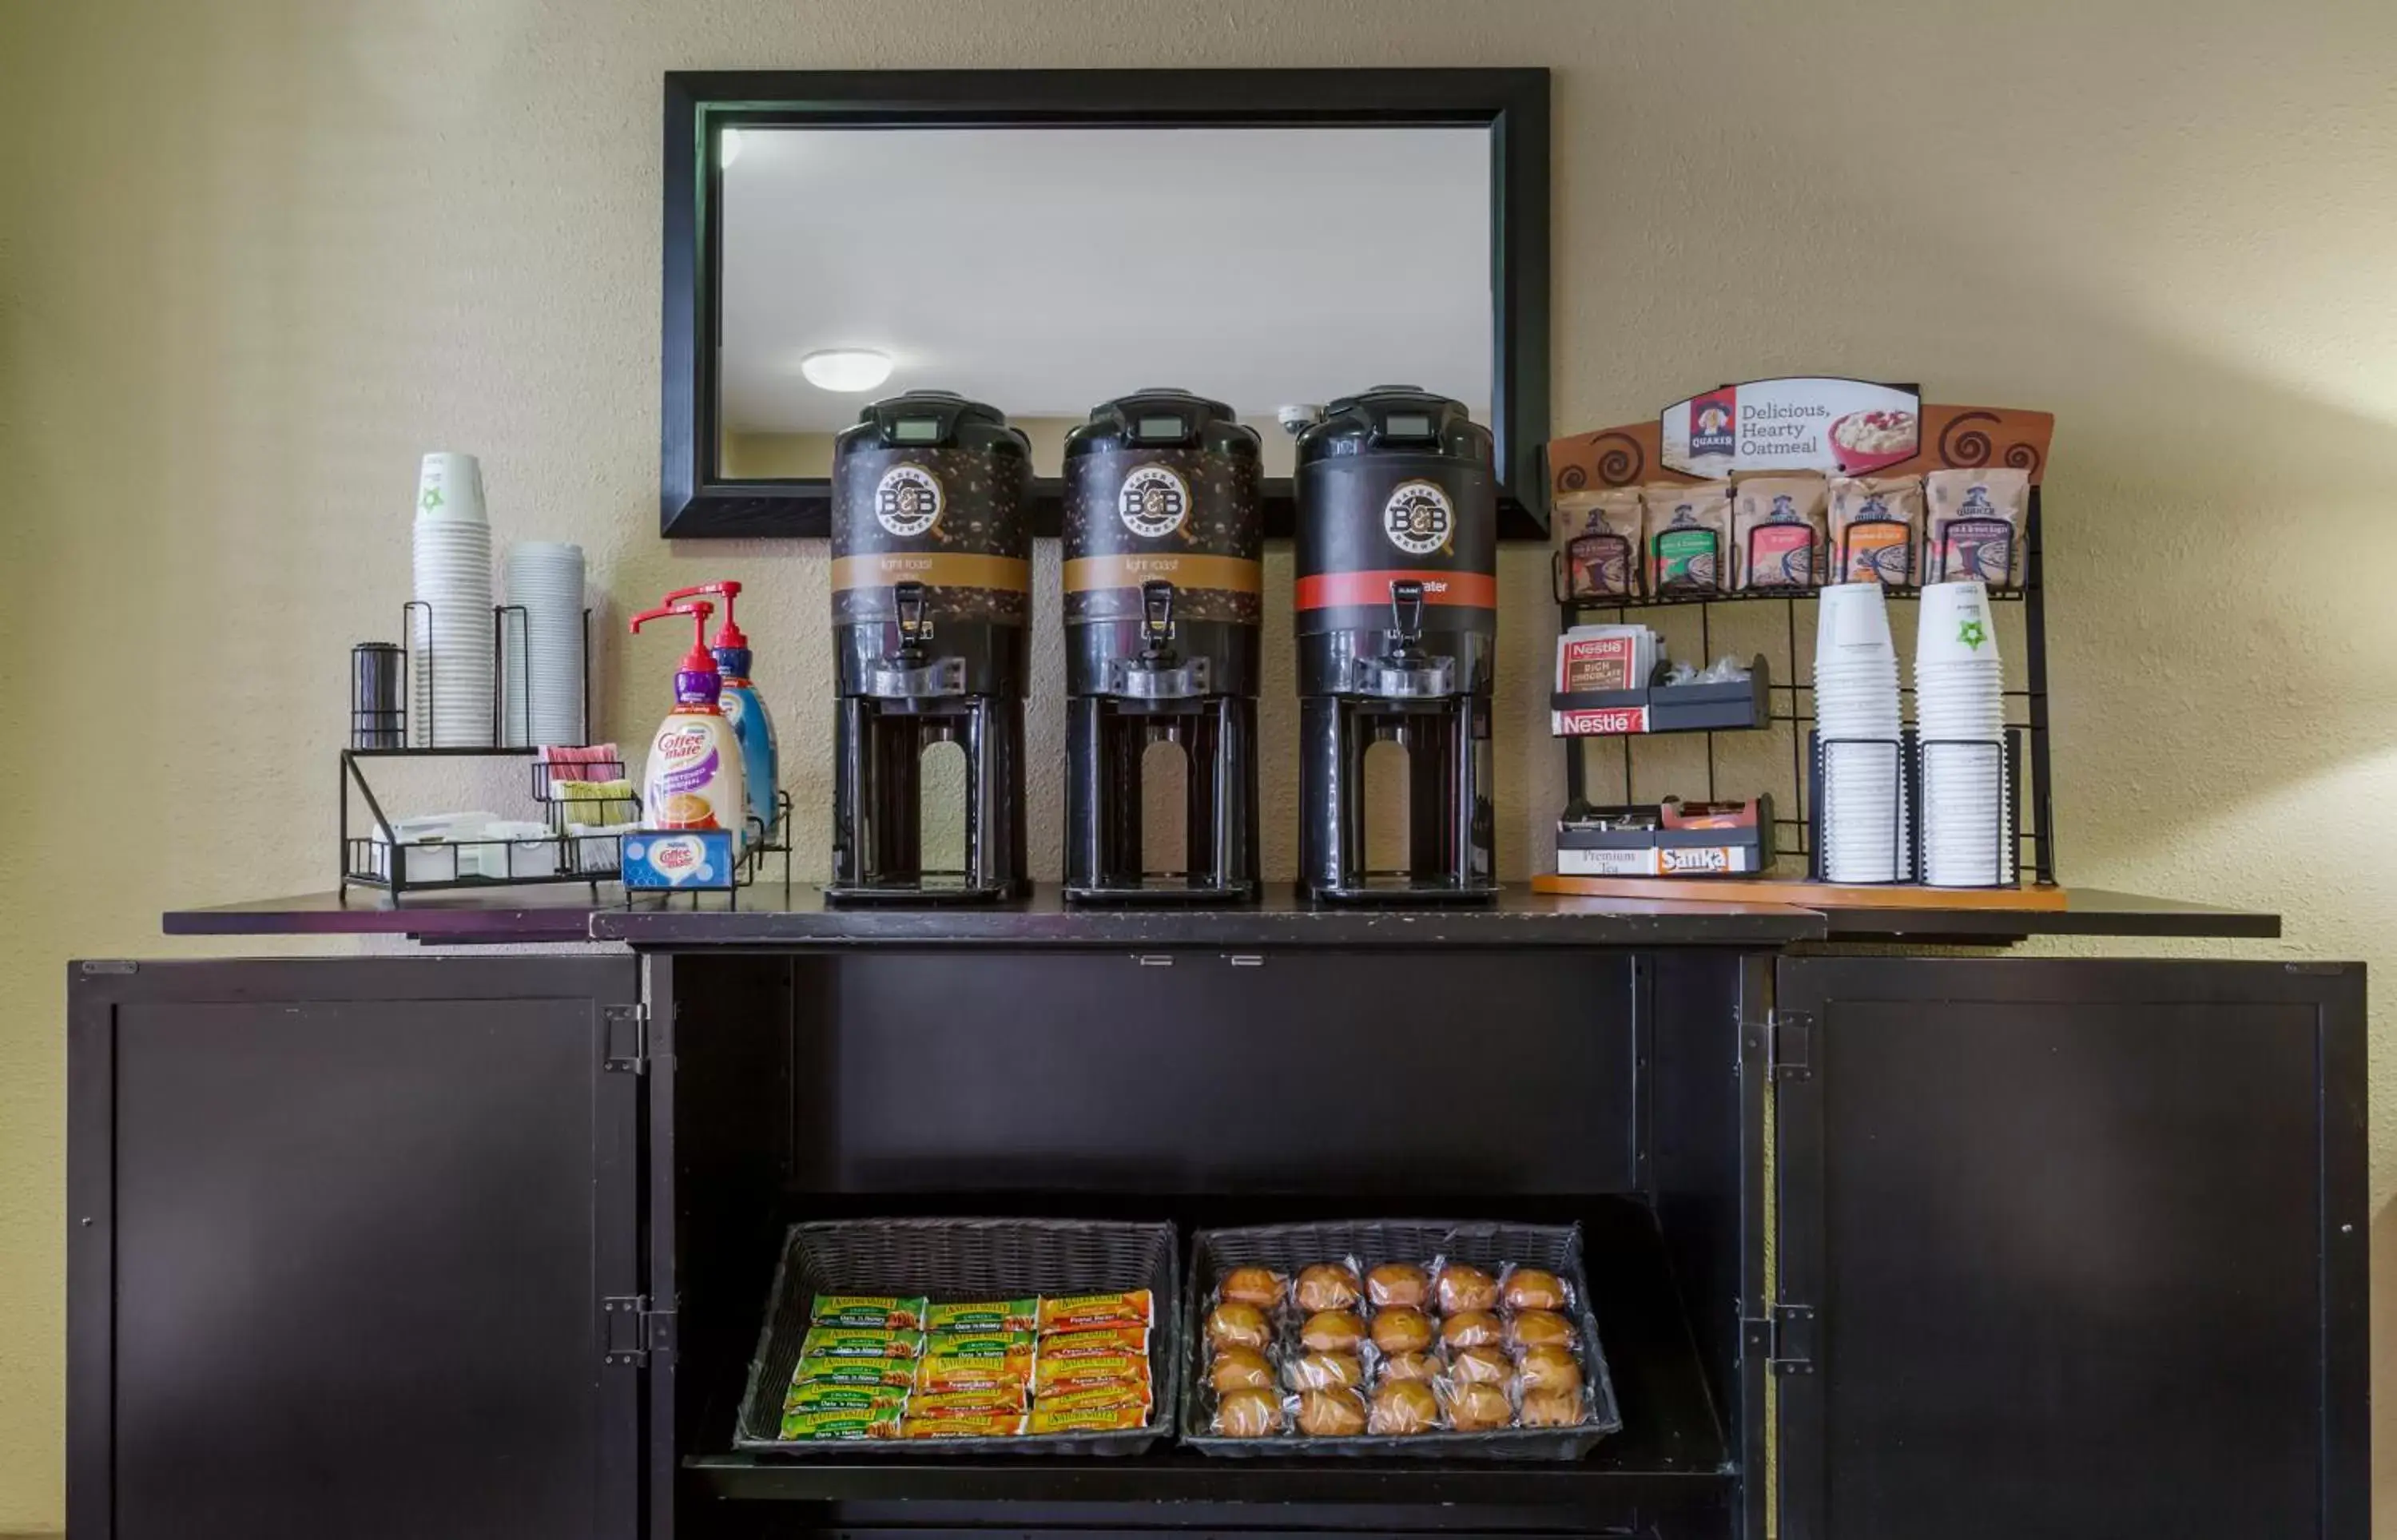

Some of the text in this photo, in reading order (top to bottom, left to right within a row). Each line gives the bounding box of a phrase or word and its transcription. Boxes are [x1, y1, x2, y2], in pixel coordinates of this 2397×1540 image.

[1742, 402, 1831, 421] Delicious,
[1742, 422, 1806, 439] Hearty
[1692, 435, 1734, 448] QUAKER
[1741, 436, 1818, 456] Oatmeal
[879, 488, 936, 516] B&B
[1123, 489, 1183, 516] B&B
[1389, 506, 1447, 534] B&B
[1422, 580, 1448, 593] ater
[658, 732, 706, 752] Coffee
[665, 744, 702, 760] mate
[1583, 849, 1636, 863] Premium
[1660, 848, 1728, 871] Sanka
[1599, 862, 1619, 875] Tea
